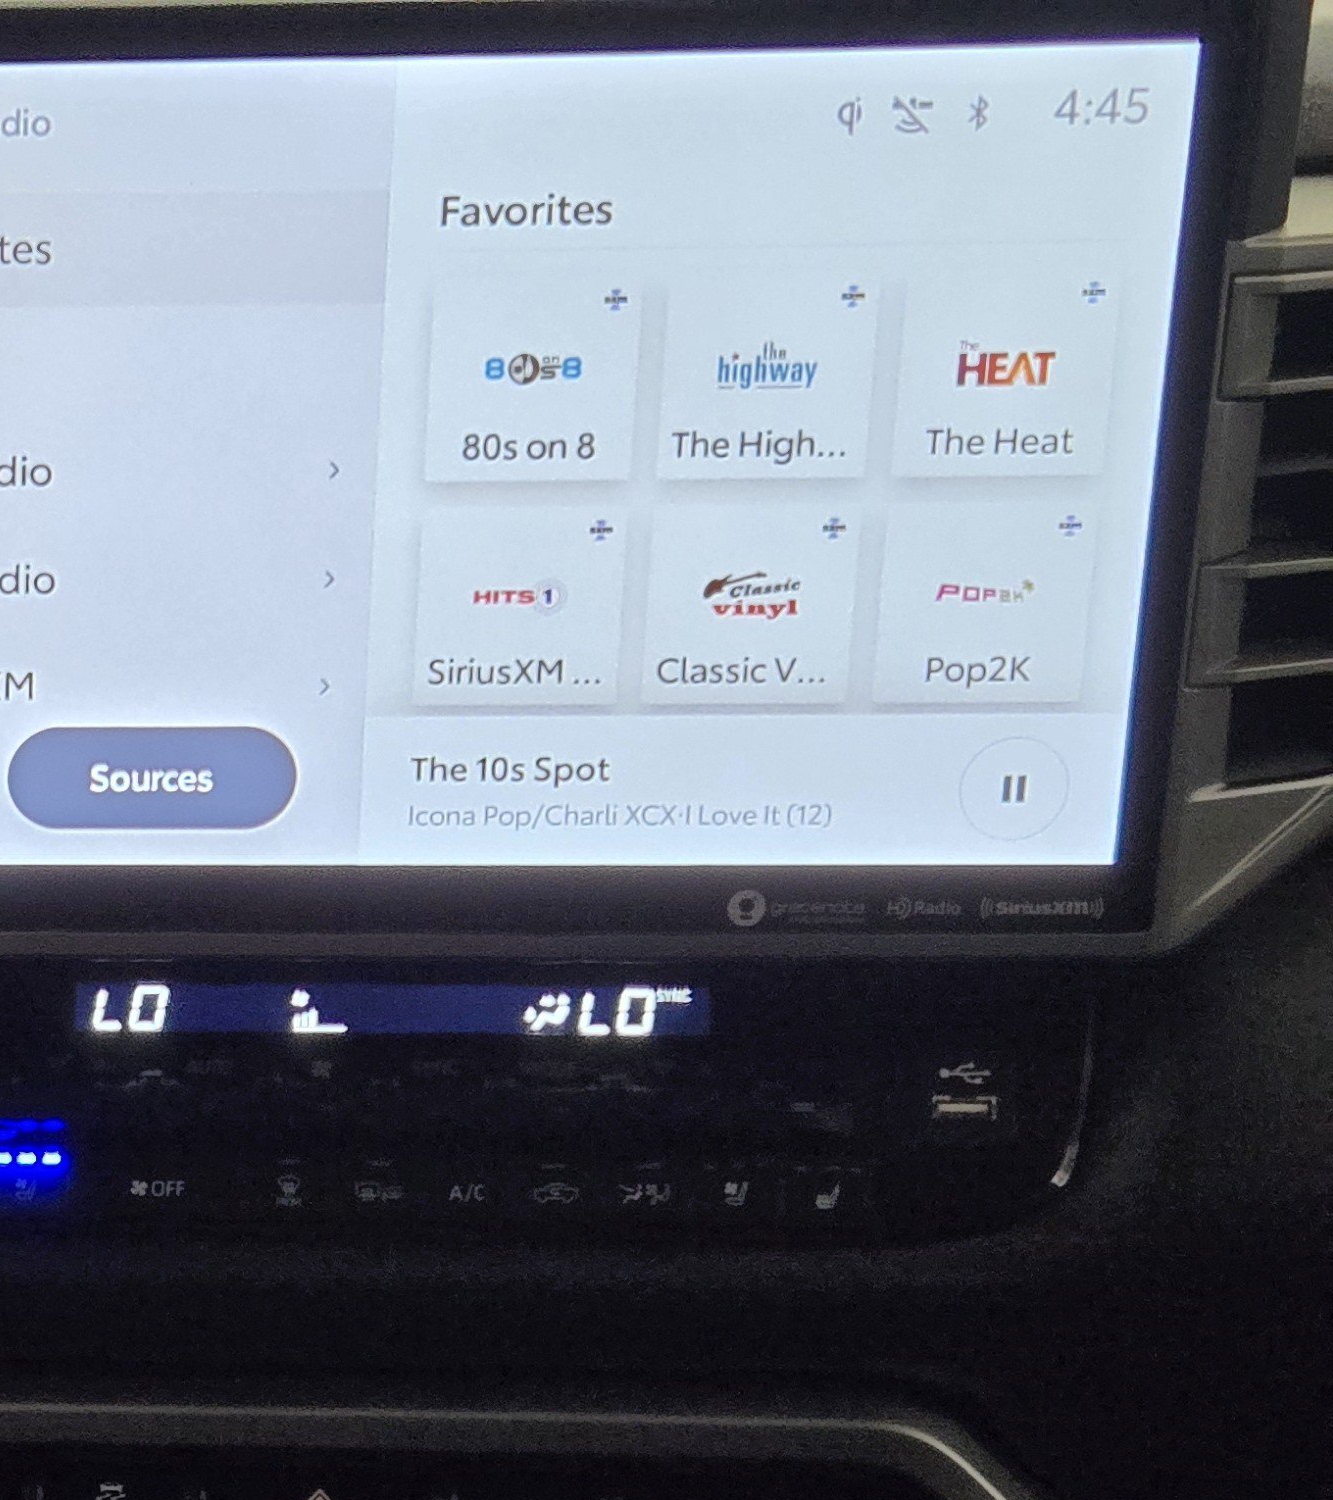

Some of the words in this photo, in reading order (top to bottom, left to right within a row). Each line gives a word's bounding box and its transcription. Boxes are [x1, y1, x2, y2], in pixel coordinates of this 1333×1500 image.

[1053, 87, 1150, 125] 4:45
[440, 194, 614, 227] Favorites
[717, 354, 819, 390] highway
[956, 351, 1057, 387] HEAT
[461, 433, 519, 462] 80s
[526, 438, 570, 462] on
[576, 434, 597, 462] 8
[671, 431, 731, 460] The
[738, 431, 847, 465] High...
[924, 428, 987, 457] The
[994, 428, 1075, 457] Heat
[473, 589, 536, 606] HITS
[728, 576, 802, 600] Classic
[712, 599, 799, 620] vinyl
[427, 657, 565, 688] SiriusXM
[656, 656, 767, 687] Classic
[924, 657, 1031, 690] Pop2K
[89, 763, 214, 795] Sources
[411, 757, 468, 783] The
[475, 757, 525, 783] 10s
[533, 756, 611, 788] Spot
[408, 805, 476, 827] Icona
[484, 803, 618, 831] Pop/Charli
[698, 804, 757, 827] Love
[763, 804, 781, 827] It
[787, 802, 832, 829] (12)
[91, 983, 173, 1033] LO
[577, 984, 657, 1037] LO
[150, 1179, 186, 1198] OFF
[448, 1184, 487, 1202] A/C
